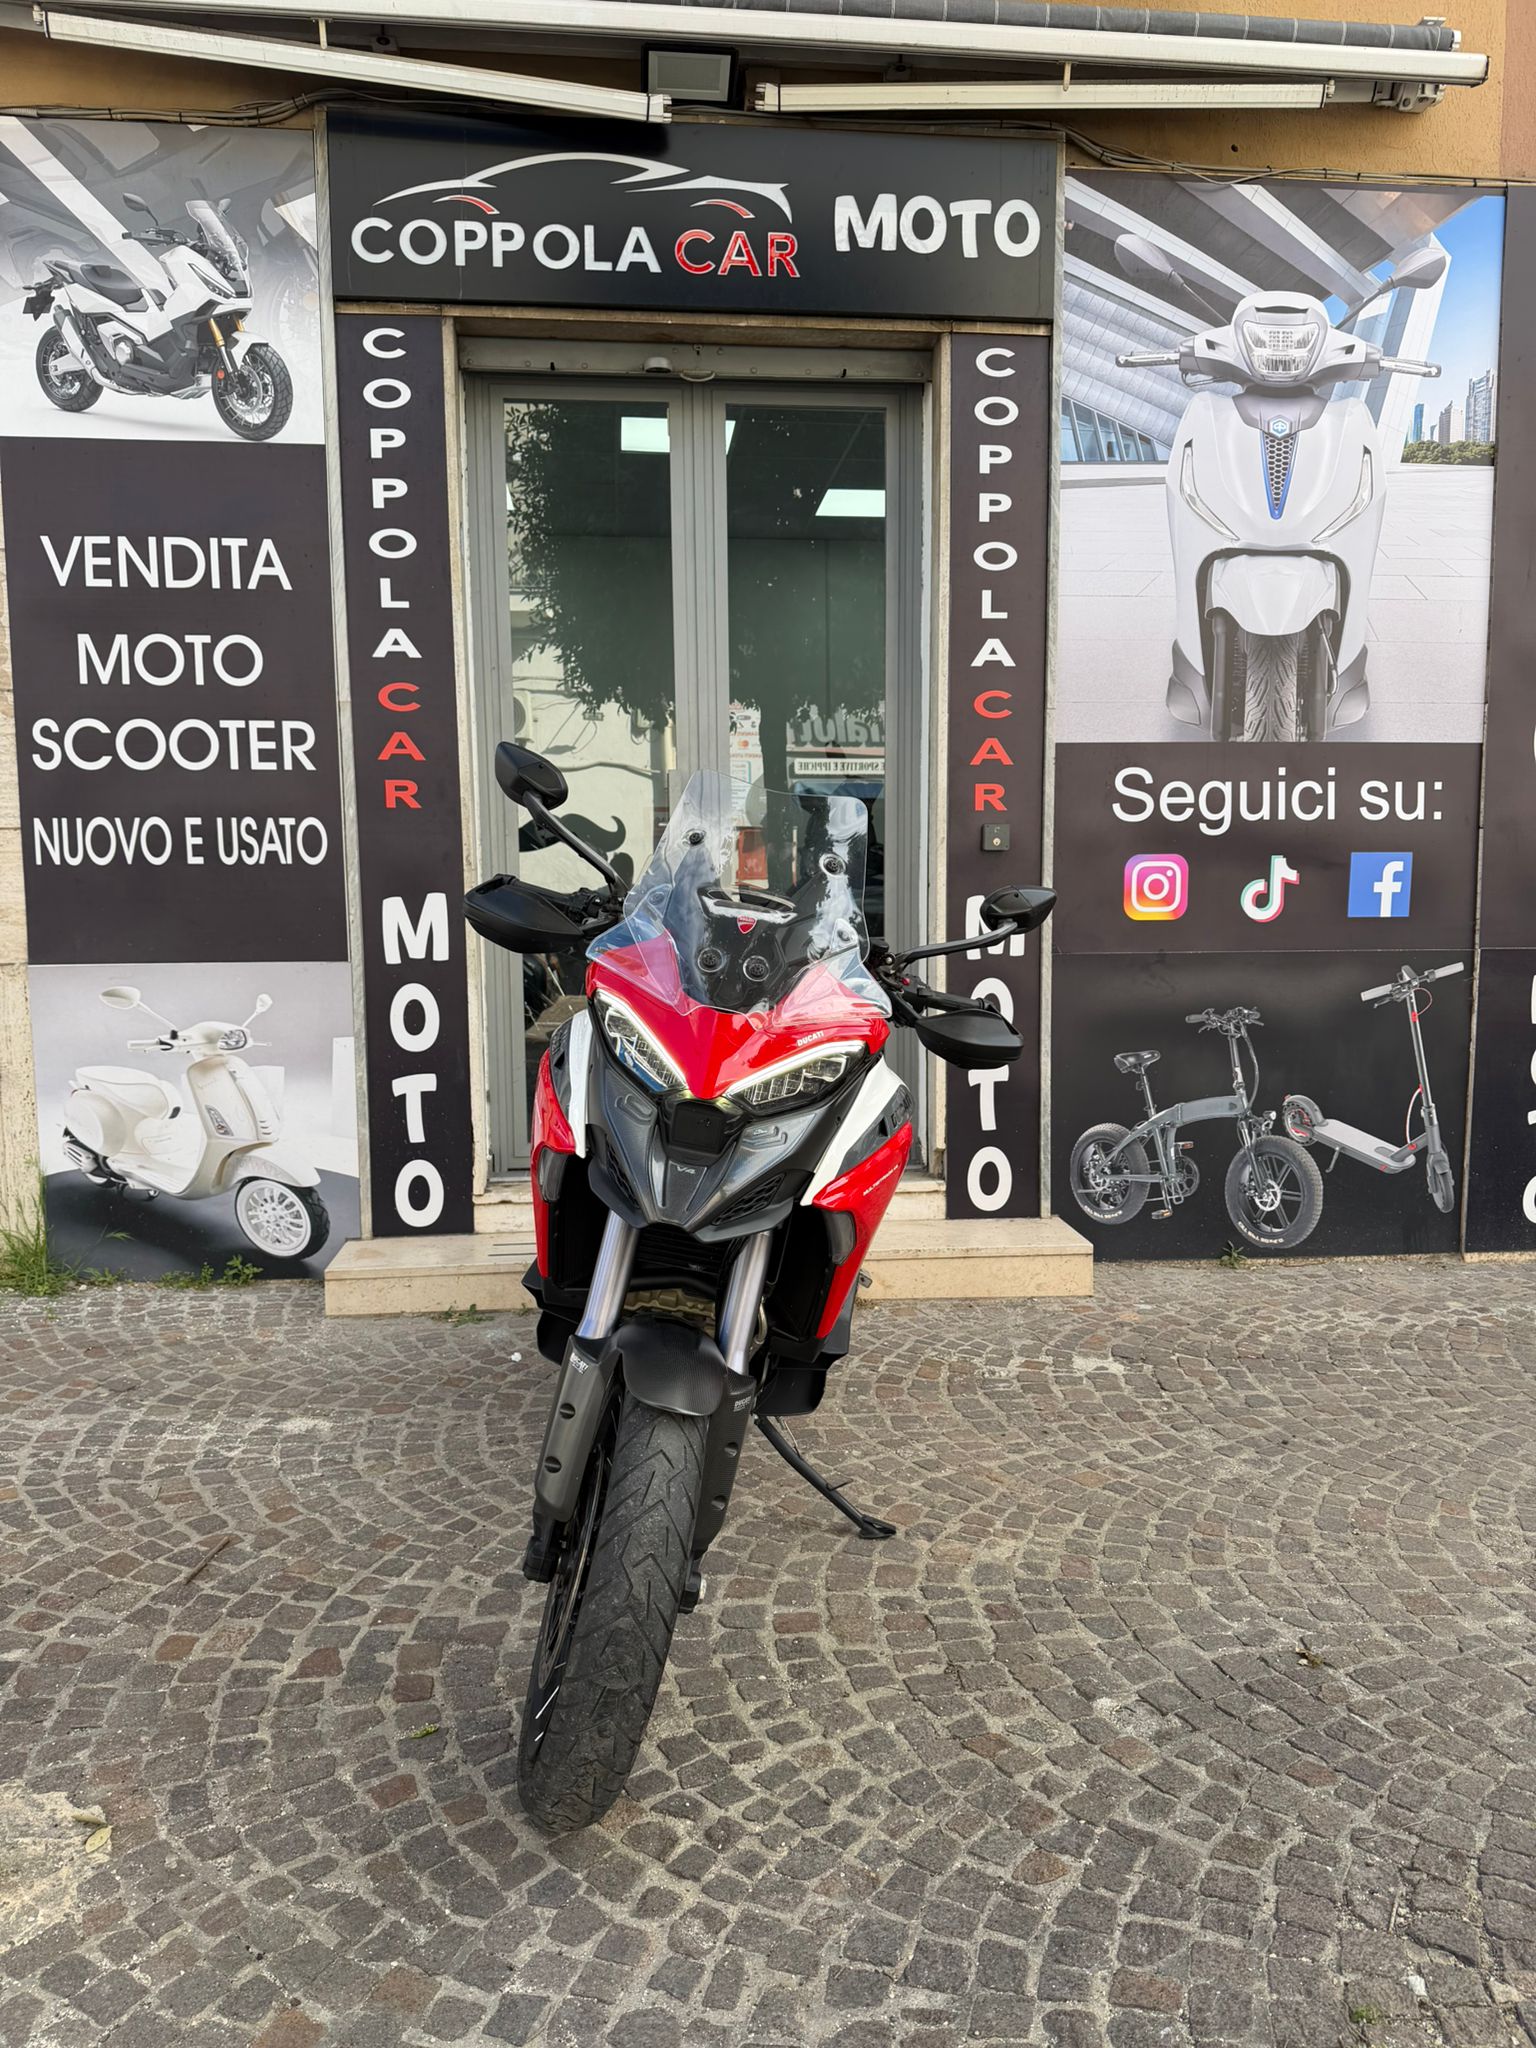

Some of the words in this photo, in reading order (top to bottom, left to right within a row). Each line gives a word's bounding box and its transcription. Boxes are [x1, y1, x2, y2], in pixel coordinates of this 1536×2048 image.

[351, 217, 662, 273] COPPOLA
[674, 230, 800, 279] CAR
[834, 193, 1041, 259] MOTO
[362, 327, 423, 659] COPPOLA
[970, 347, 1019, 667] COPPOLA
[39, 535, 293, 591] VENDITA
[77, 633, 264, 687] MOTO
[32, 717, 317, 771] SCOOTER
[376, 681, 425, 810] CAR
[970, 688, 1014, 812] CAR
[1111, 766, 1337, 836] Seguici
[1359, 780, 1443, 821] su:
[33, 816, 173, 866] NUOVO
[184, 817, 205, 865] E
[216, 816, 328, 866] USATO
[382, 892, 450, 1228] MOTO
[796, 1030, 825, 1047] DUCATI
